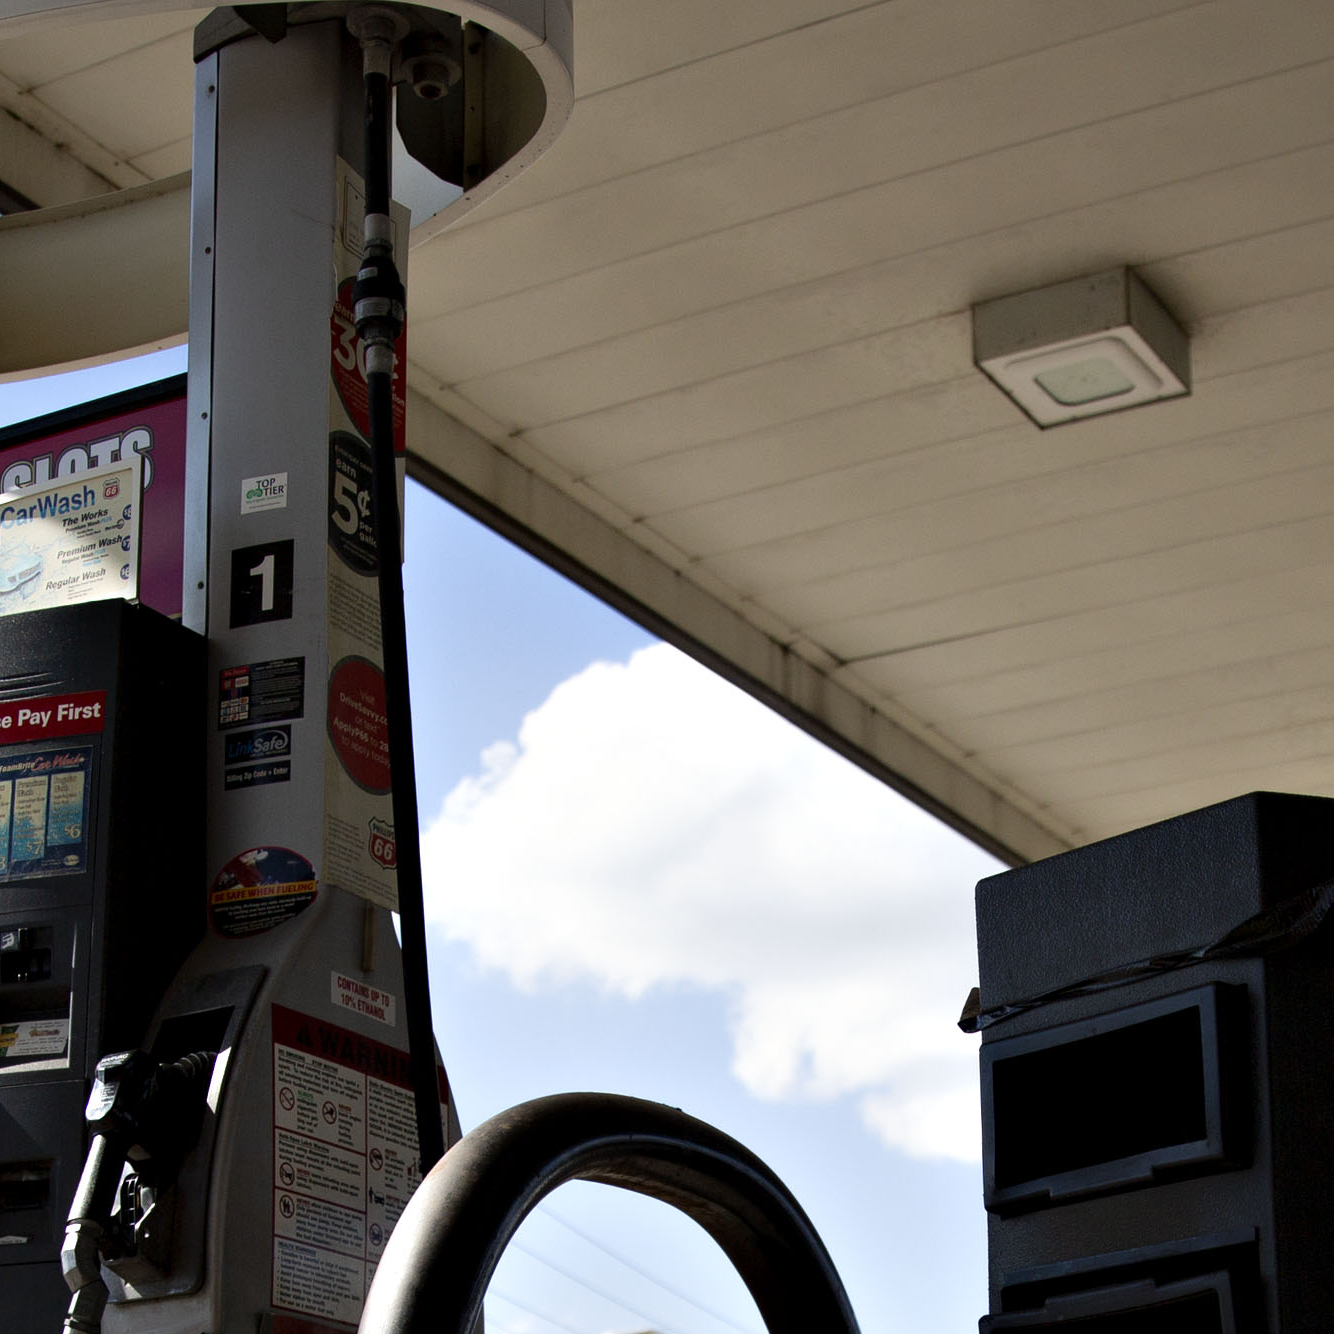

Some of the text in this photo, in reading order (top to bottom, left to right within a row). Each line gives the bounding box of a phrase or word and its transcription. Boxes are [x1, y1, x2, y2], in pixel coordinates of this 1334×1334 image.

[256, 477, 276, 489] TOP
[263, 485, 284, 497] TIER
[62, 516, 78, 527] The
[81, 509, 108, 521] Works
[57, 543, 96, 560] Premium
[99, 534, 123, 550] Wash
[46, 575, 79, 591] Regular
[82, 568, 106, 582] Wash
[249, 554, 275, 611] 1
[17, 708, 52, 727] Pay
[57, 702, 102, 721] First
[375, 839, 394, 861] 66
[227, 890, 245, 900] SAFE
[248, 887, 275, 898] WHEN
[277, 882, 314, 894] FUELING
[337, 976, 390, 1007] CONTAINS UP TO
[341, 993, 386, 1021] 10% ETHANOL
[320, 1027, 413, 1084] WARNIN
